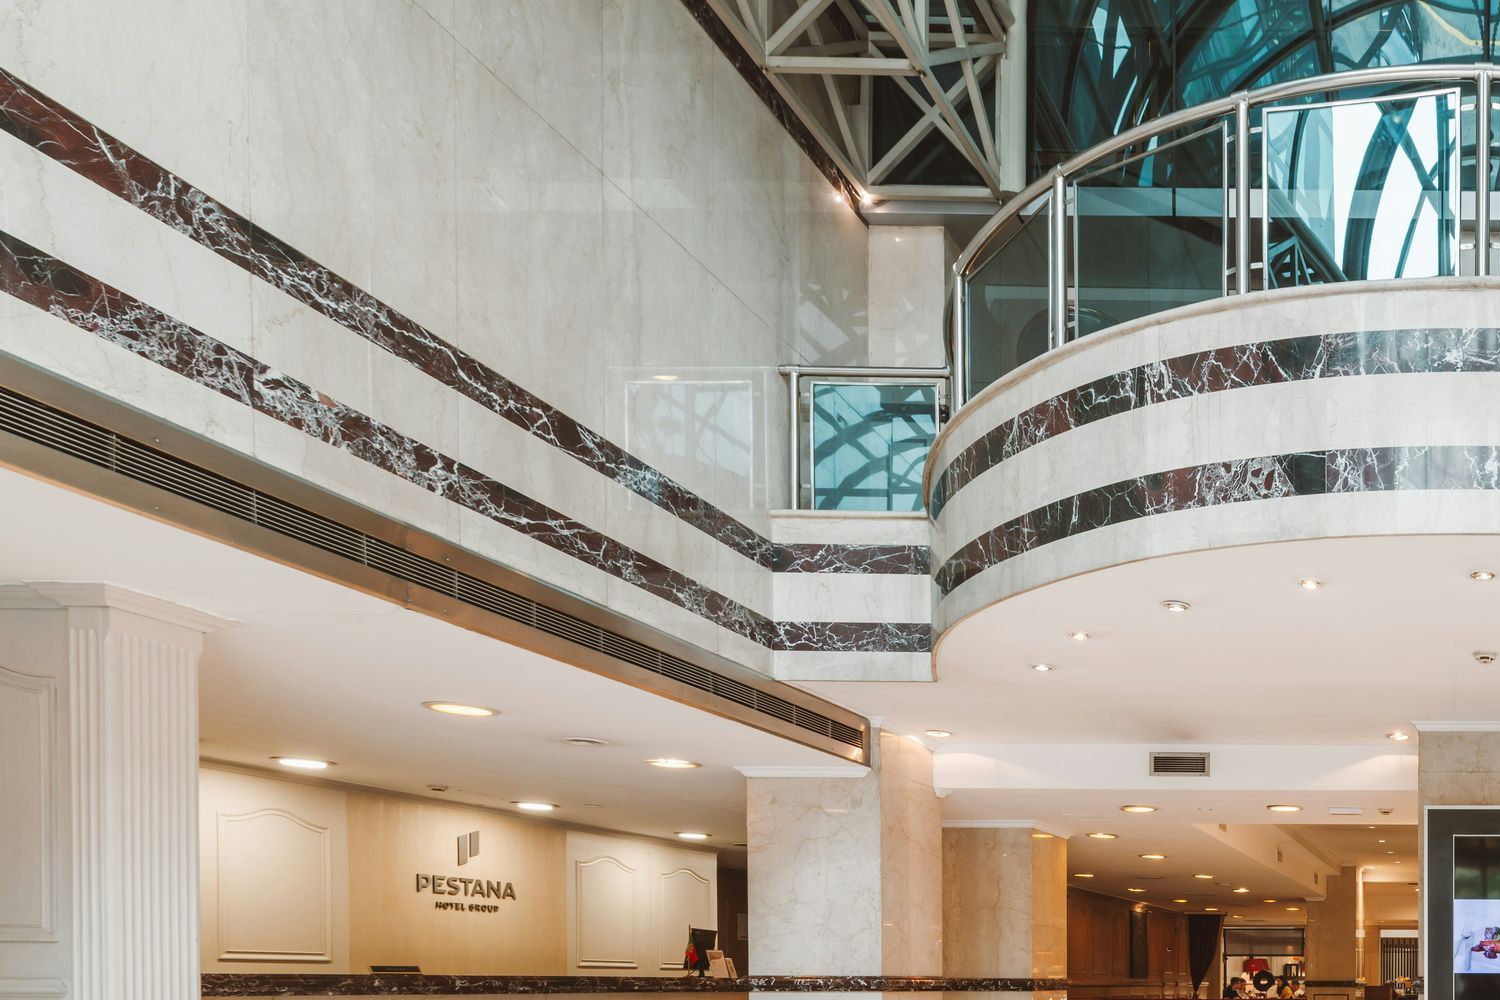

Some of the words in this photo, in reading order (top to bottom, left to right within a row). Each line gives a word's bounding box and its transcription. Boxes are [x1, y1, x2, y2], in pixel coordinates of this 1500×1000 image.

[416, 873, 516, 900] PESTANA
[435, 901, 465, 911] HOTEL
[468, 904, 499, 913] GROUP
